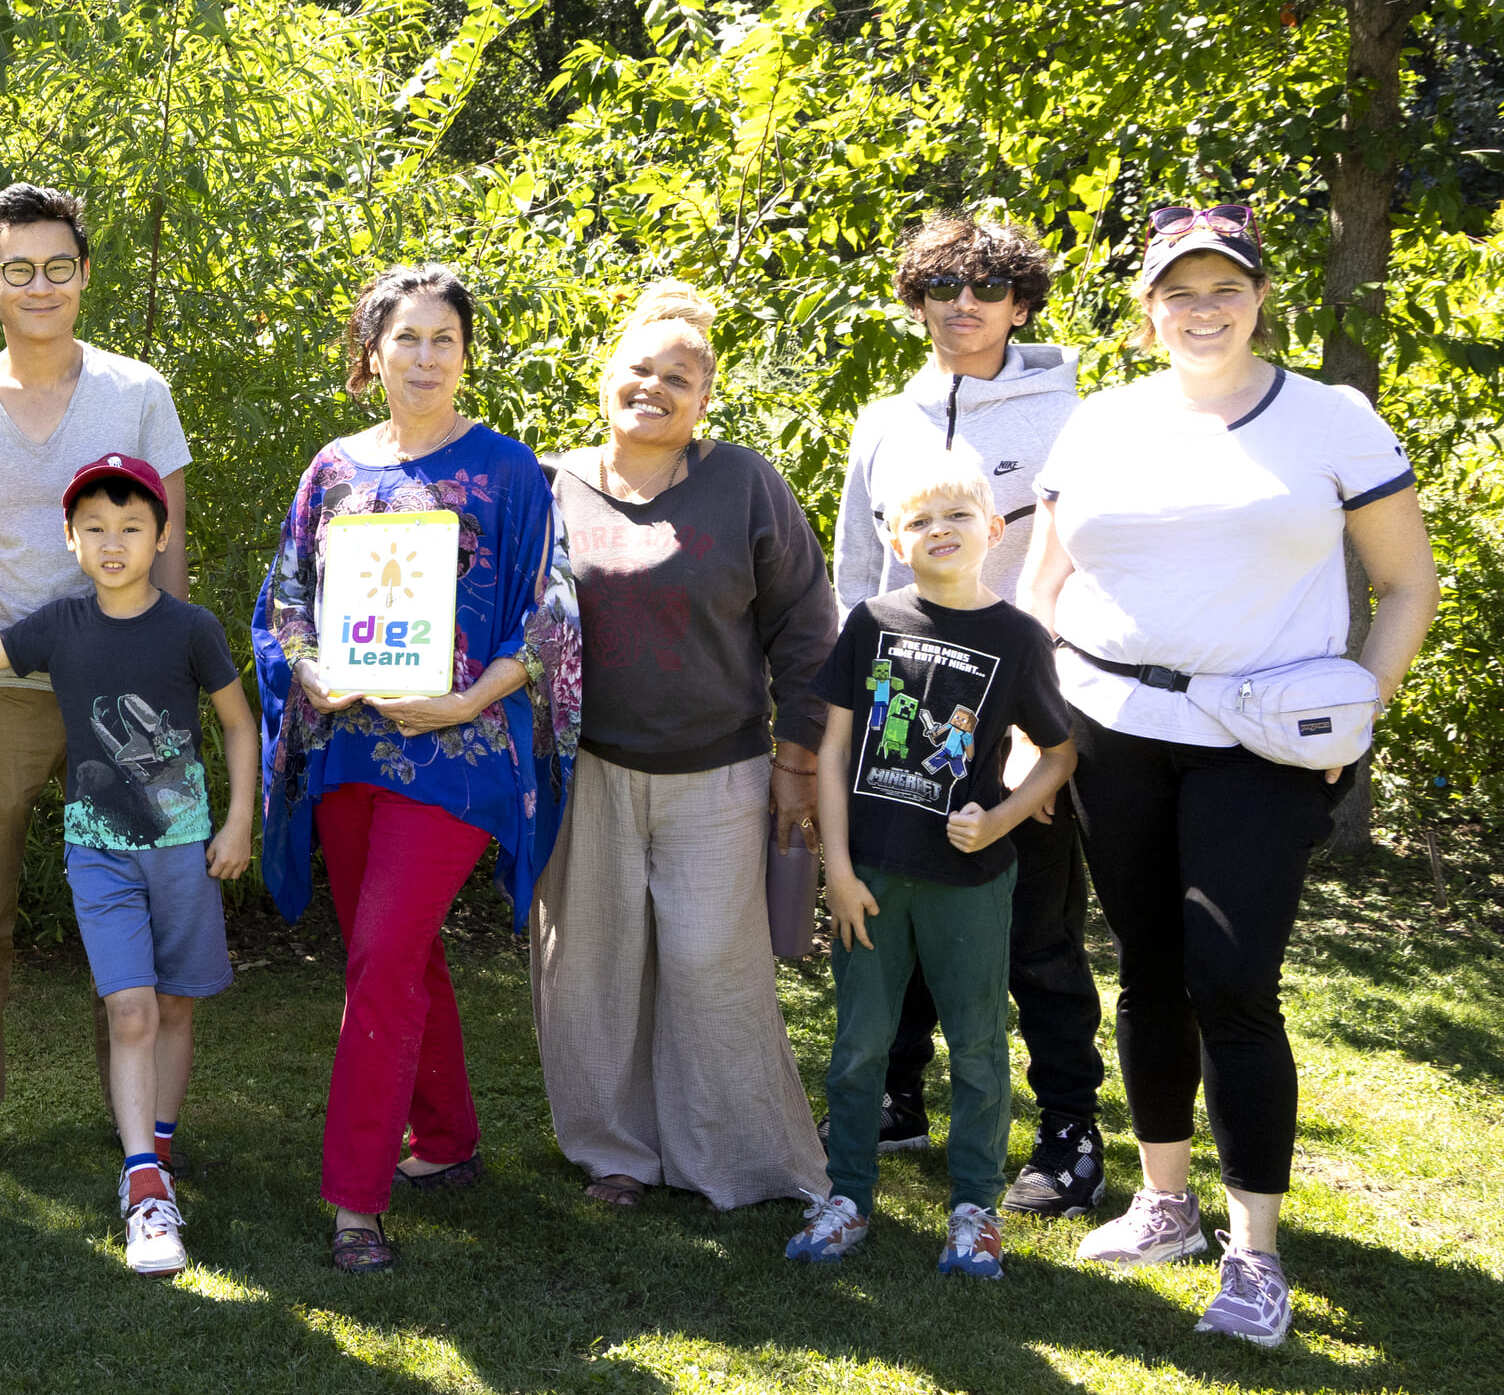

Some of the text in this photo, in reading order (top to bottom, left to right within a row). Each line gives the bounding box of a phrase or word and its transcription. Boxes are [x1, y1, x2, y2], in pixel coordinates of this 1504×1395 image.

[998, 460, 1019, 470] NIKE
[342, 615, 432, 648] idig2
[902, 639, 921, 650] THE
[348, 647, 421, 666] Learn
